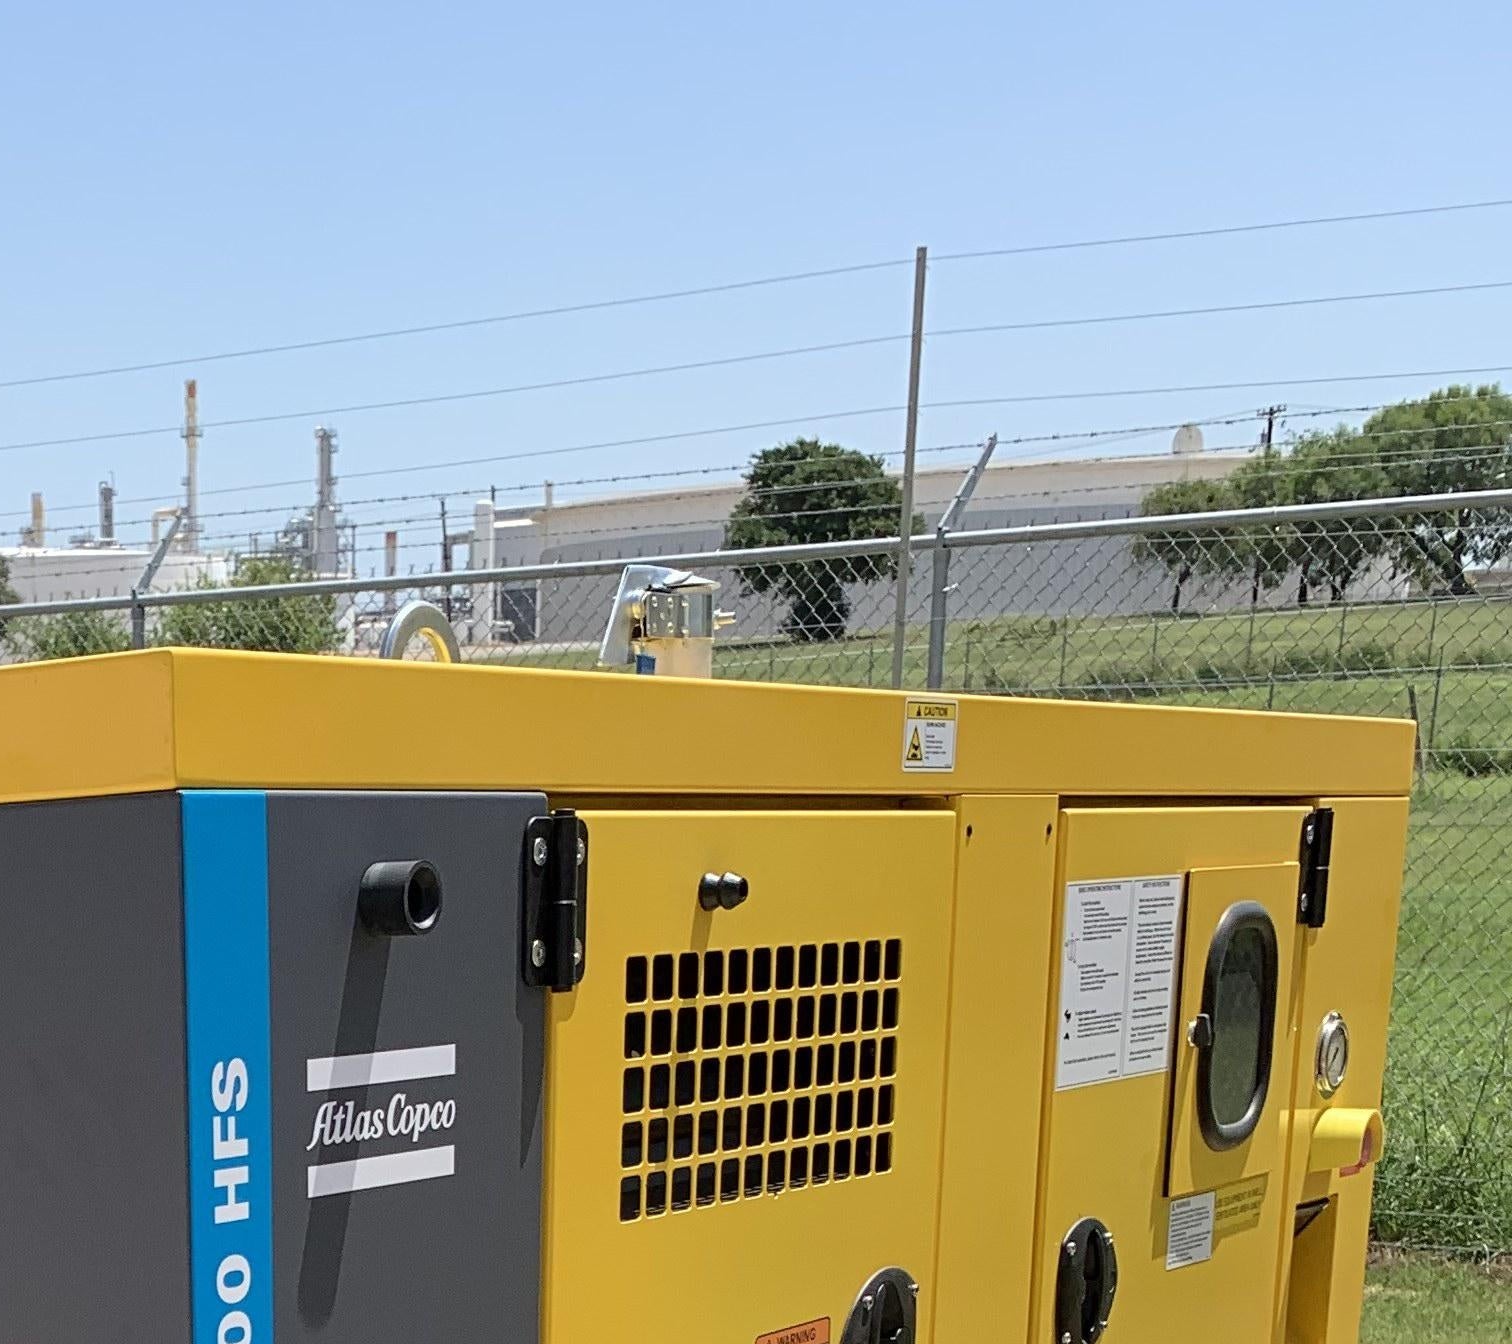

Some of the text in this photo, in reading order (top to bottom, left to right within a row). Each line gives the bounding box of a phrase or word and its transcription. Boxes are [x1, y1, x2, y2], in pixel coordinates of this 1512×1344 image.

[212, 1056, 249, 1224] HFS
[306, 1093, 456, 1150] Atlas Copco
